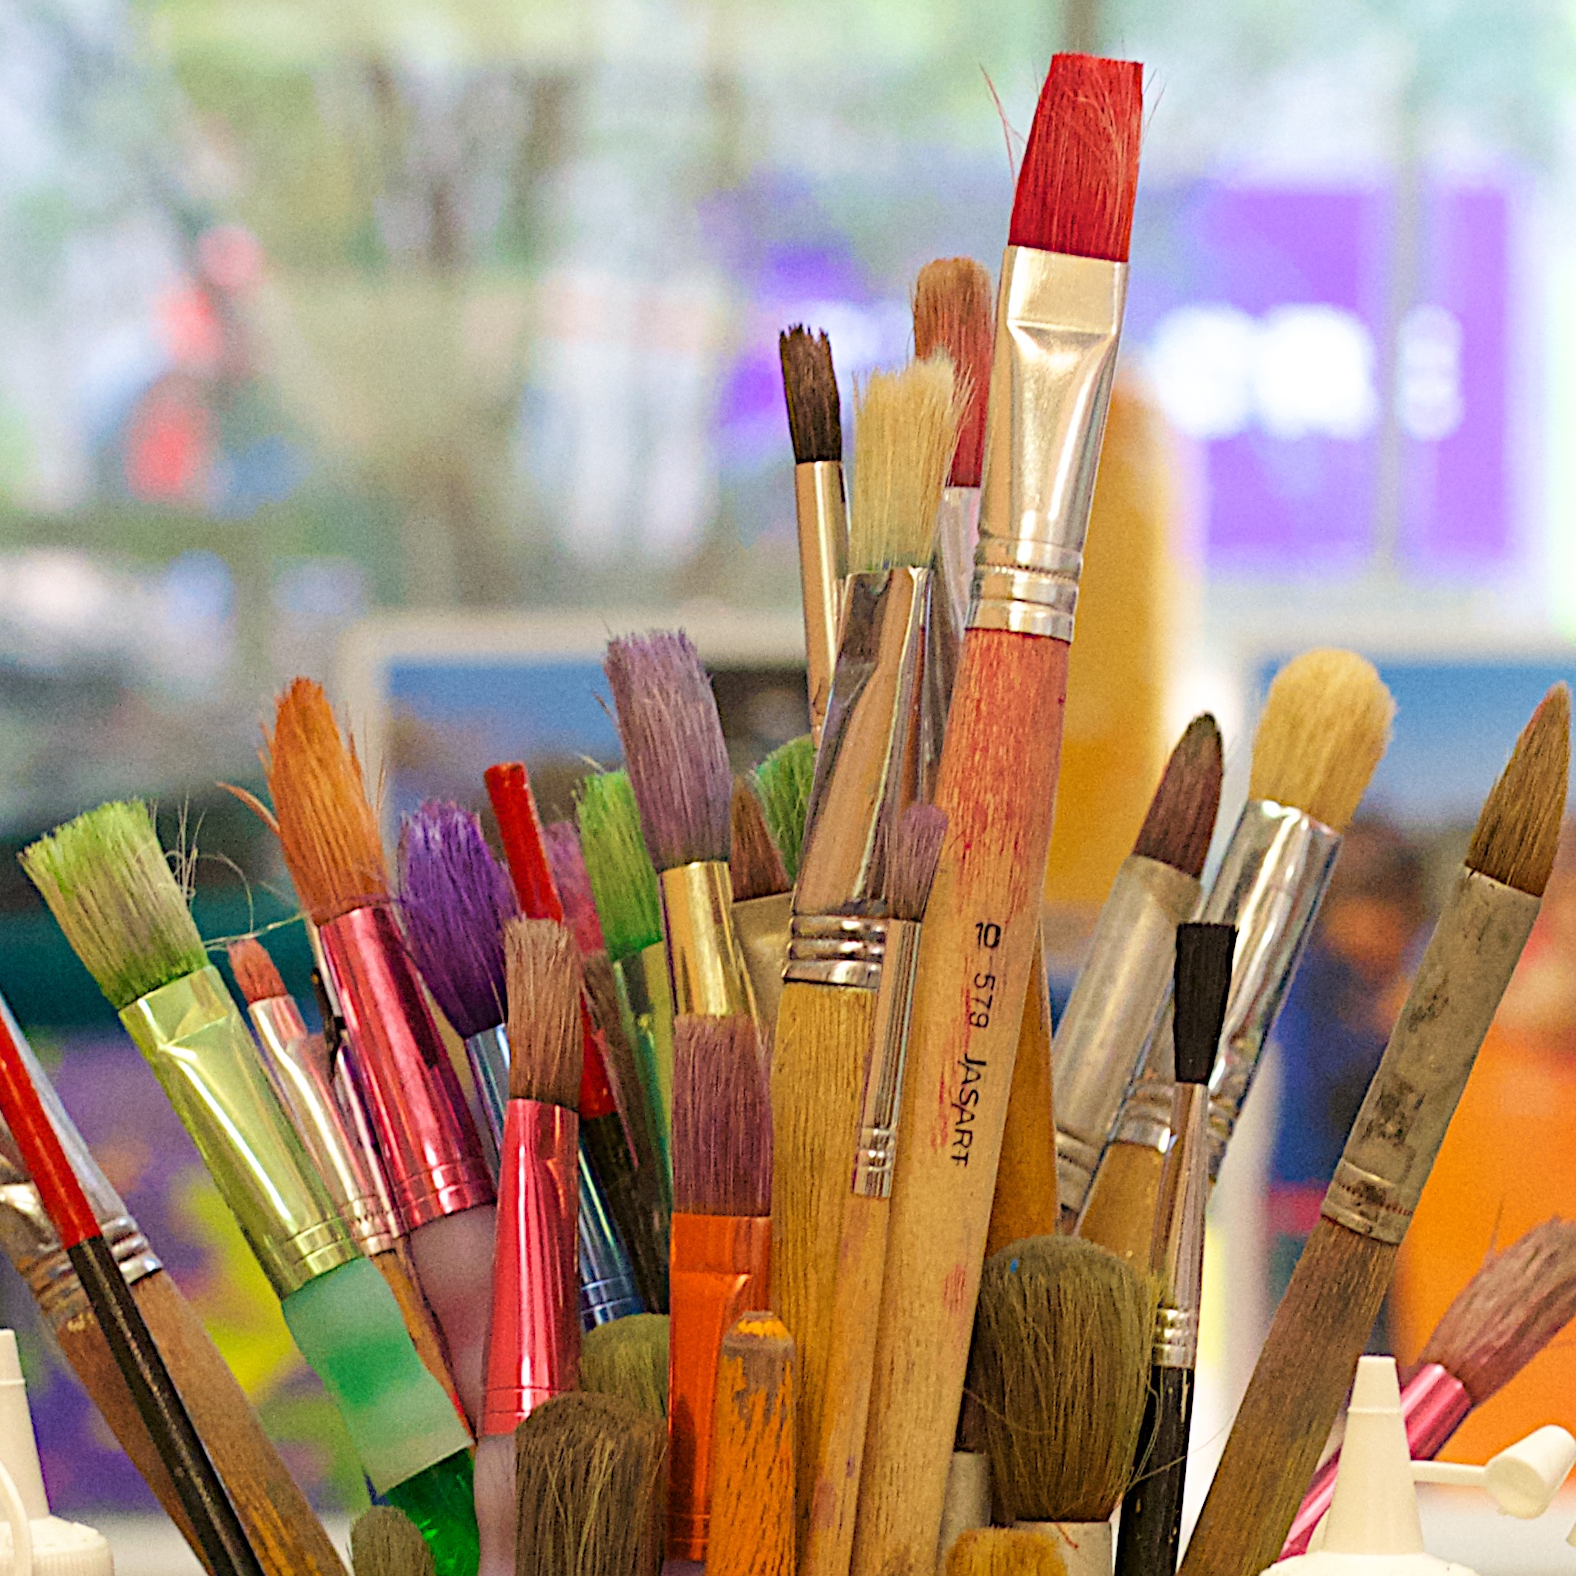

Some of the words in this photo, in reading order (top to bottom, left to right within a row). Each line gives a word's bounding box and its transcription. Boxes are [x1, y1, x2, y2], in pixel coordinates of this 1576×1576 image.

[975, 921, 1001, 950] 10
[969, 972, 996, 1029] 579
[950, 1052, 987, 1168] JASART
